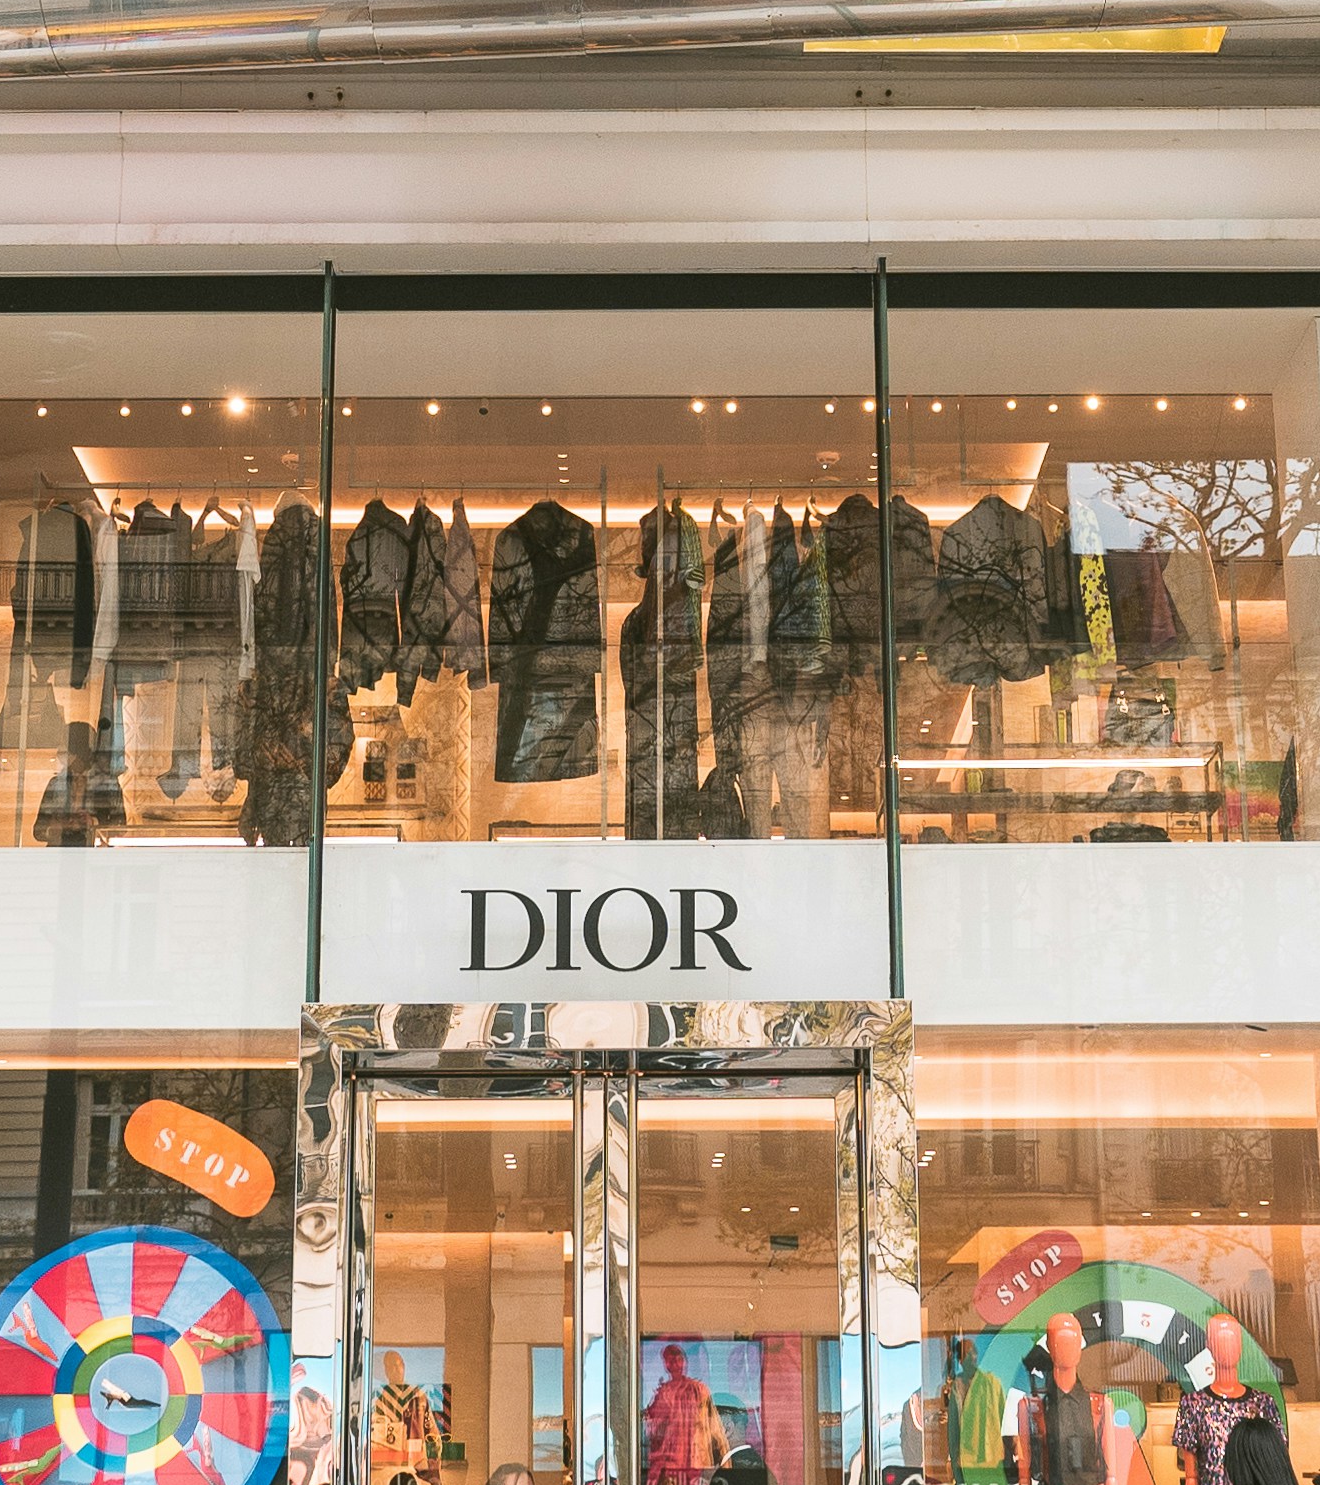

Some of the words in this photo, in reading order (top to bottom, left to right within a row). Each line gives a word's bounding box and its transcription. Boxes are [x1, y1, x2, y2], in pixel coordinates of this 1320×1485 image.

[459, 887, 753, 972] DIOR
[154, 1128, 250, 1188] STOP
[996, 1244, 1063, 1306] STOP
